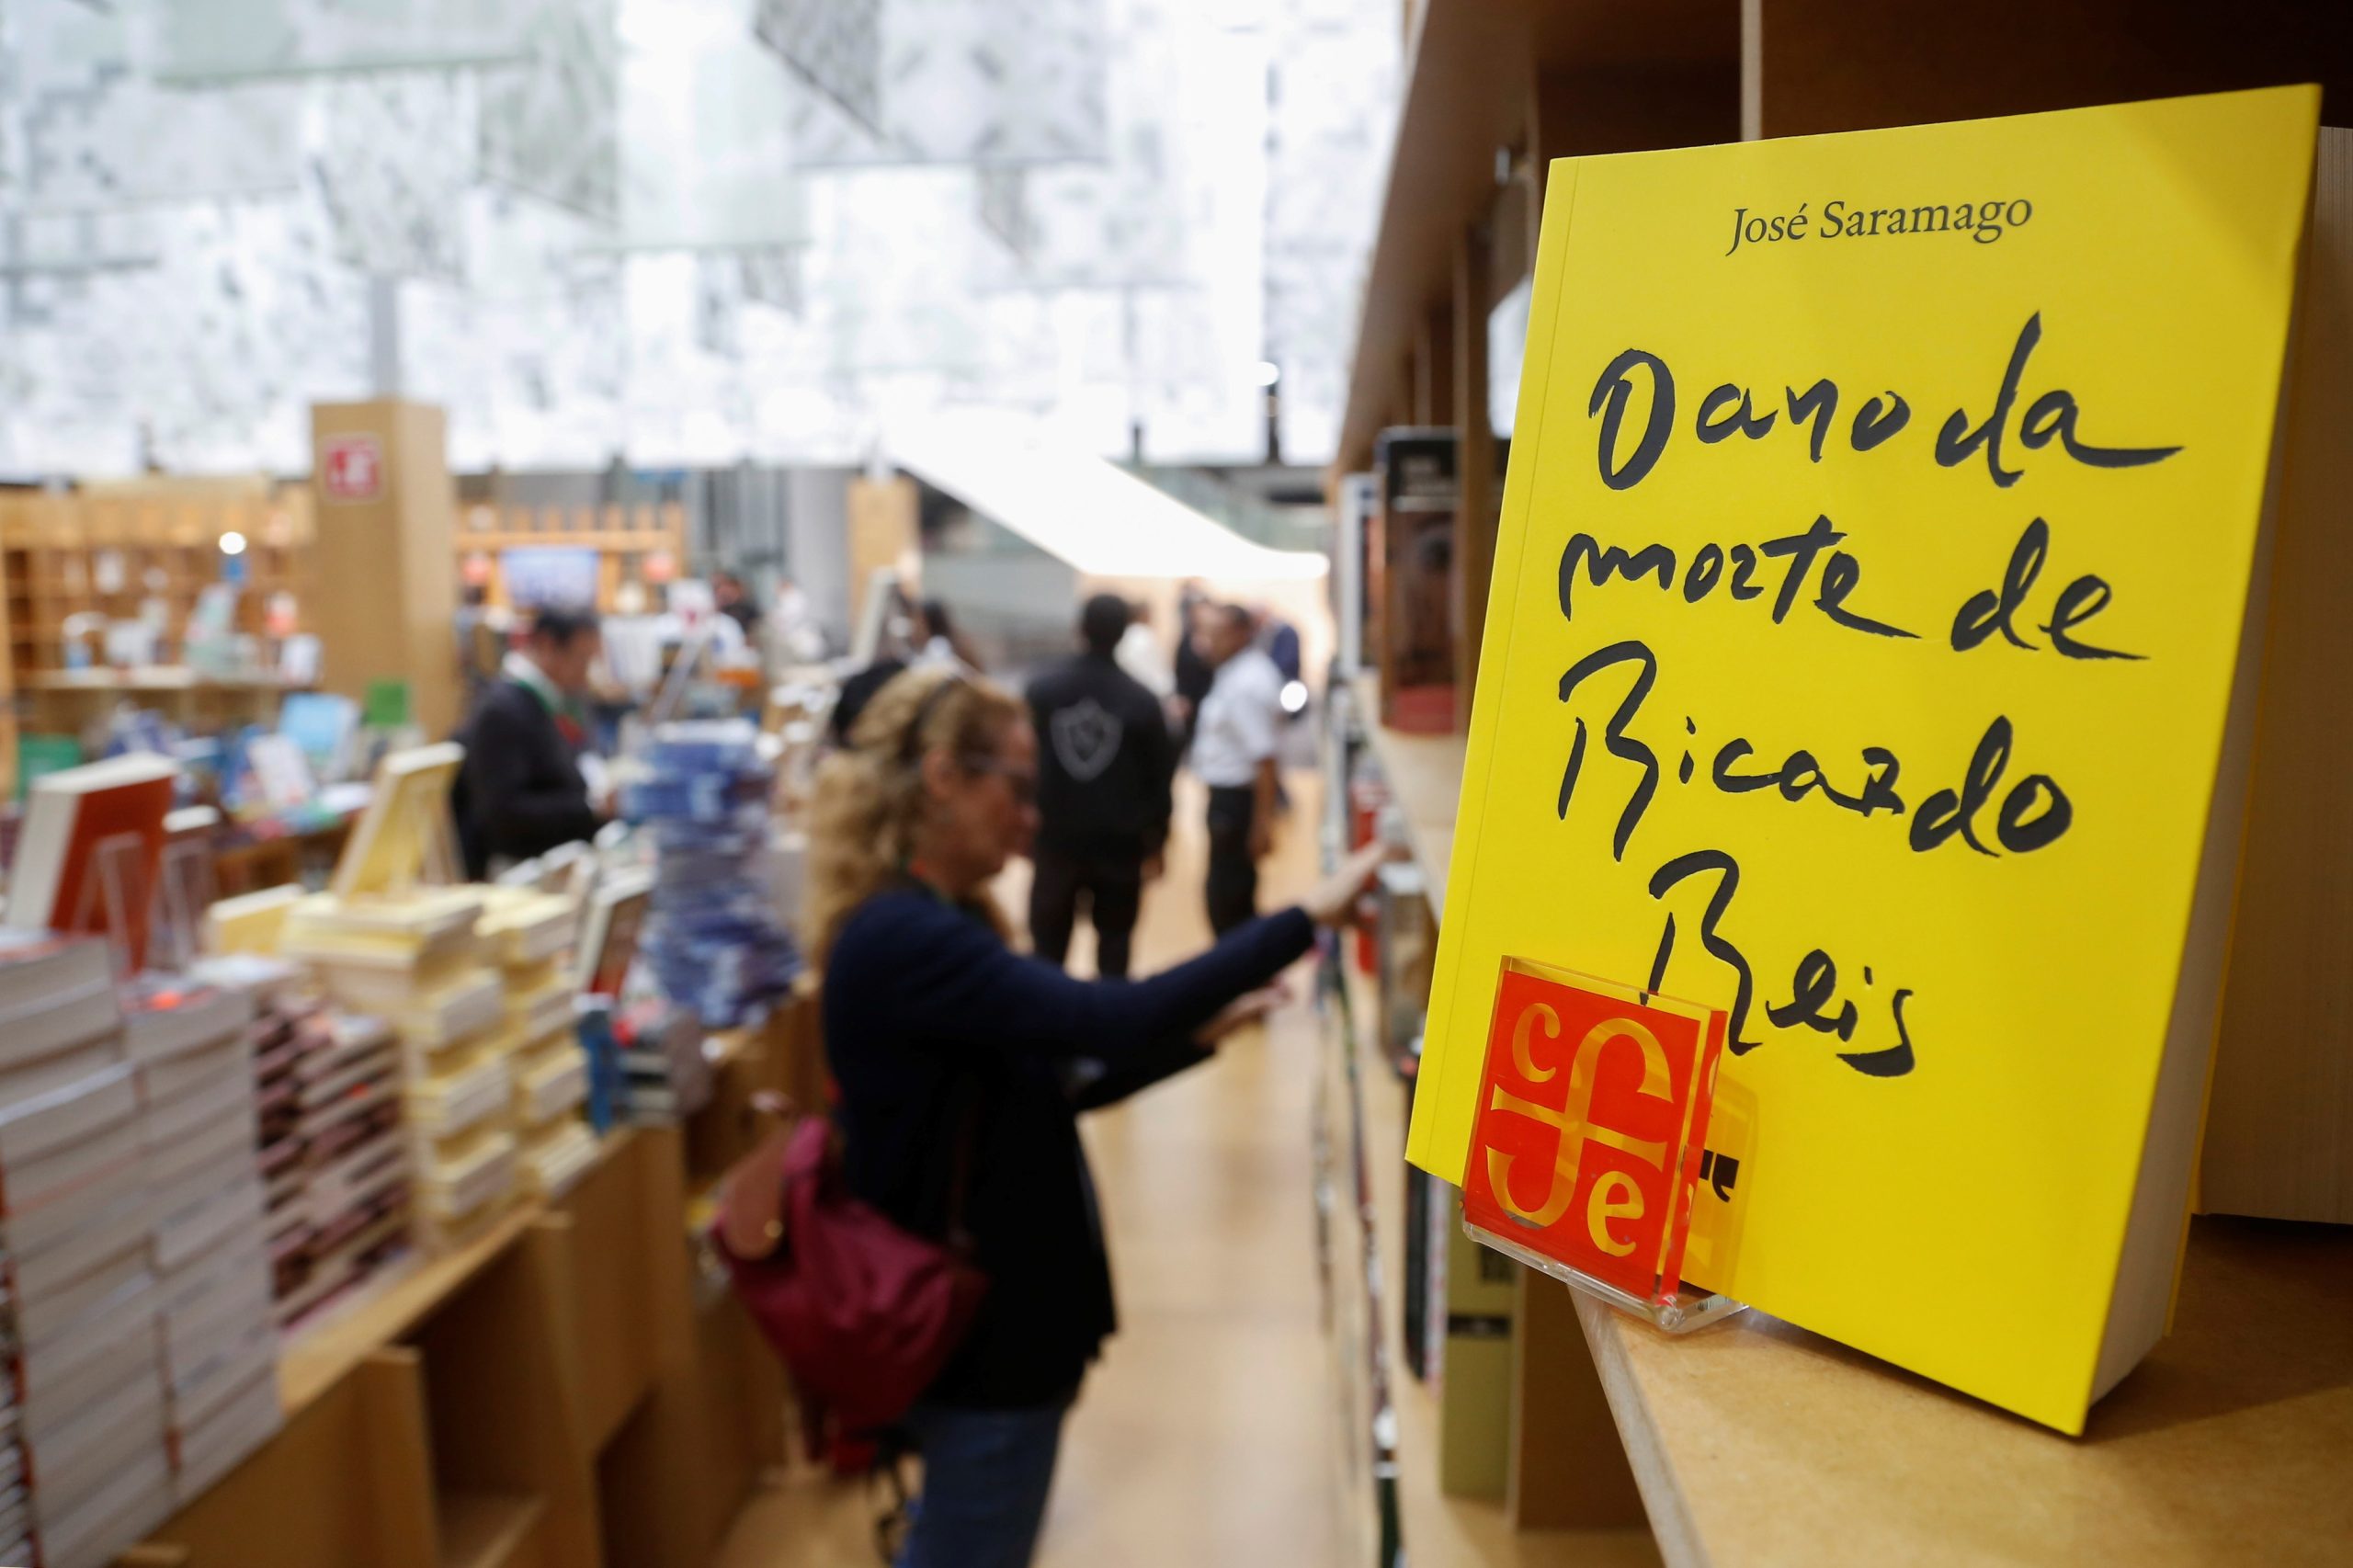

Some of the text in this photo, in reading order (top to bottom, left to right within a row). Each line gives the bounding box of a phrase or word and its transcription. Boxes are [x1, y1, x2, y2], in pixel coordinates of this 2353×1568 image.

[1726, 199, 2033, 257] José Saramago
[1588, 311, 2185, 491] O ano da
[1558, 514, 2149, 661] morte de
[1557, 640, 2074, 863] Ricardo
[1639, 848, 1915, 1078] Reis
